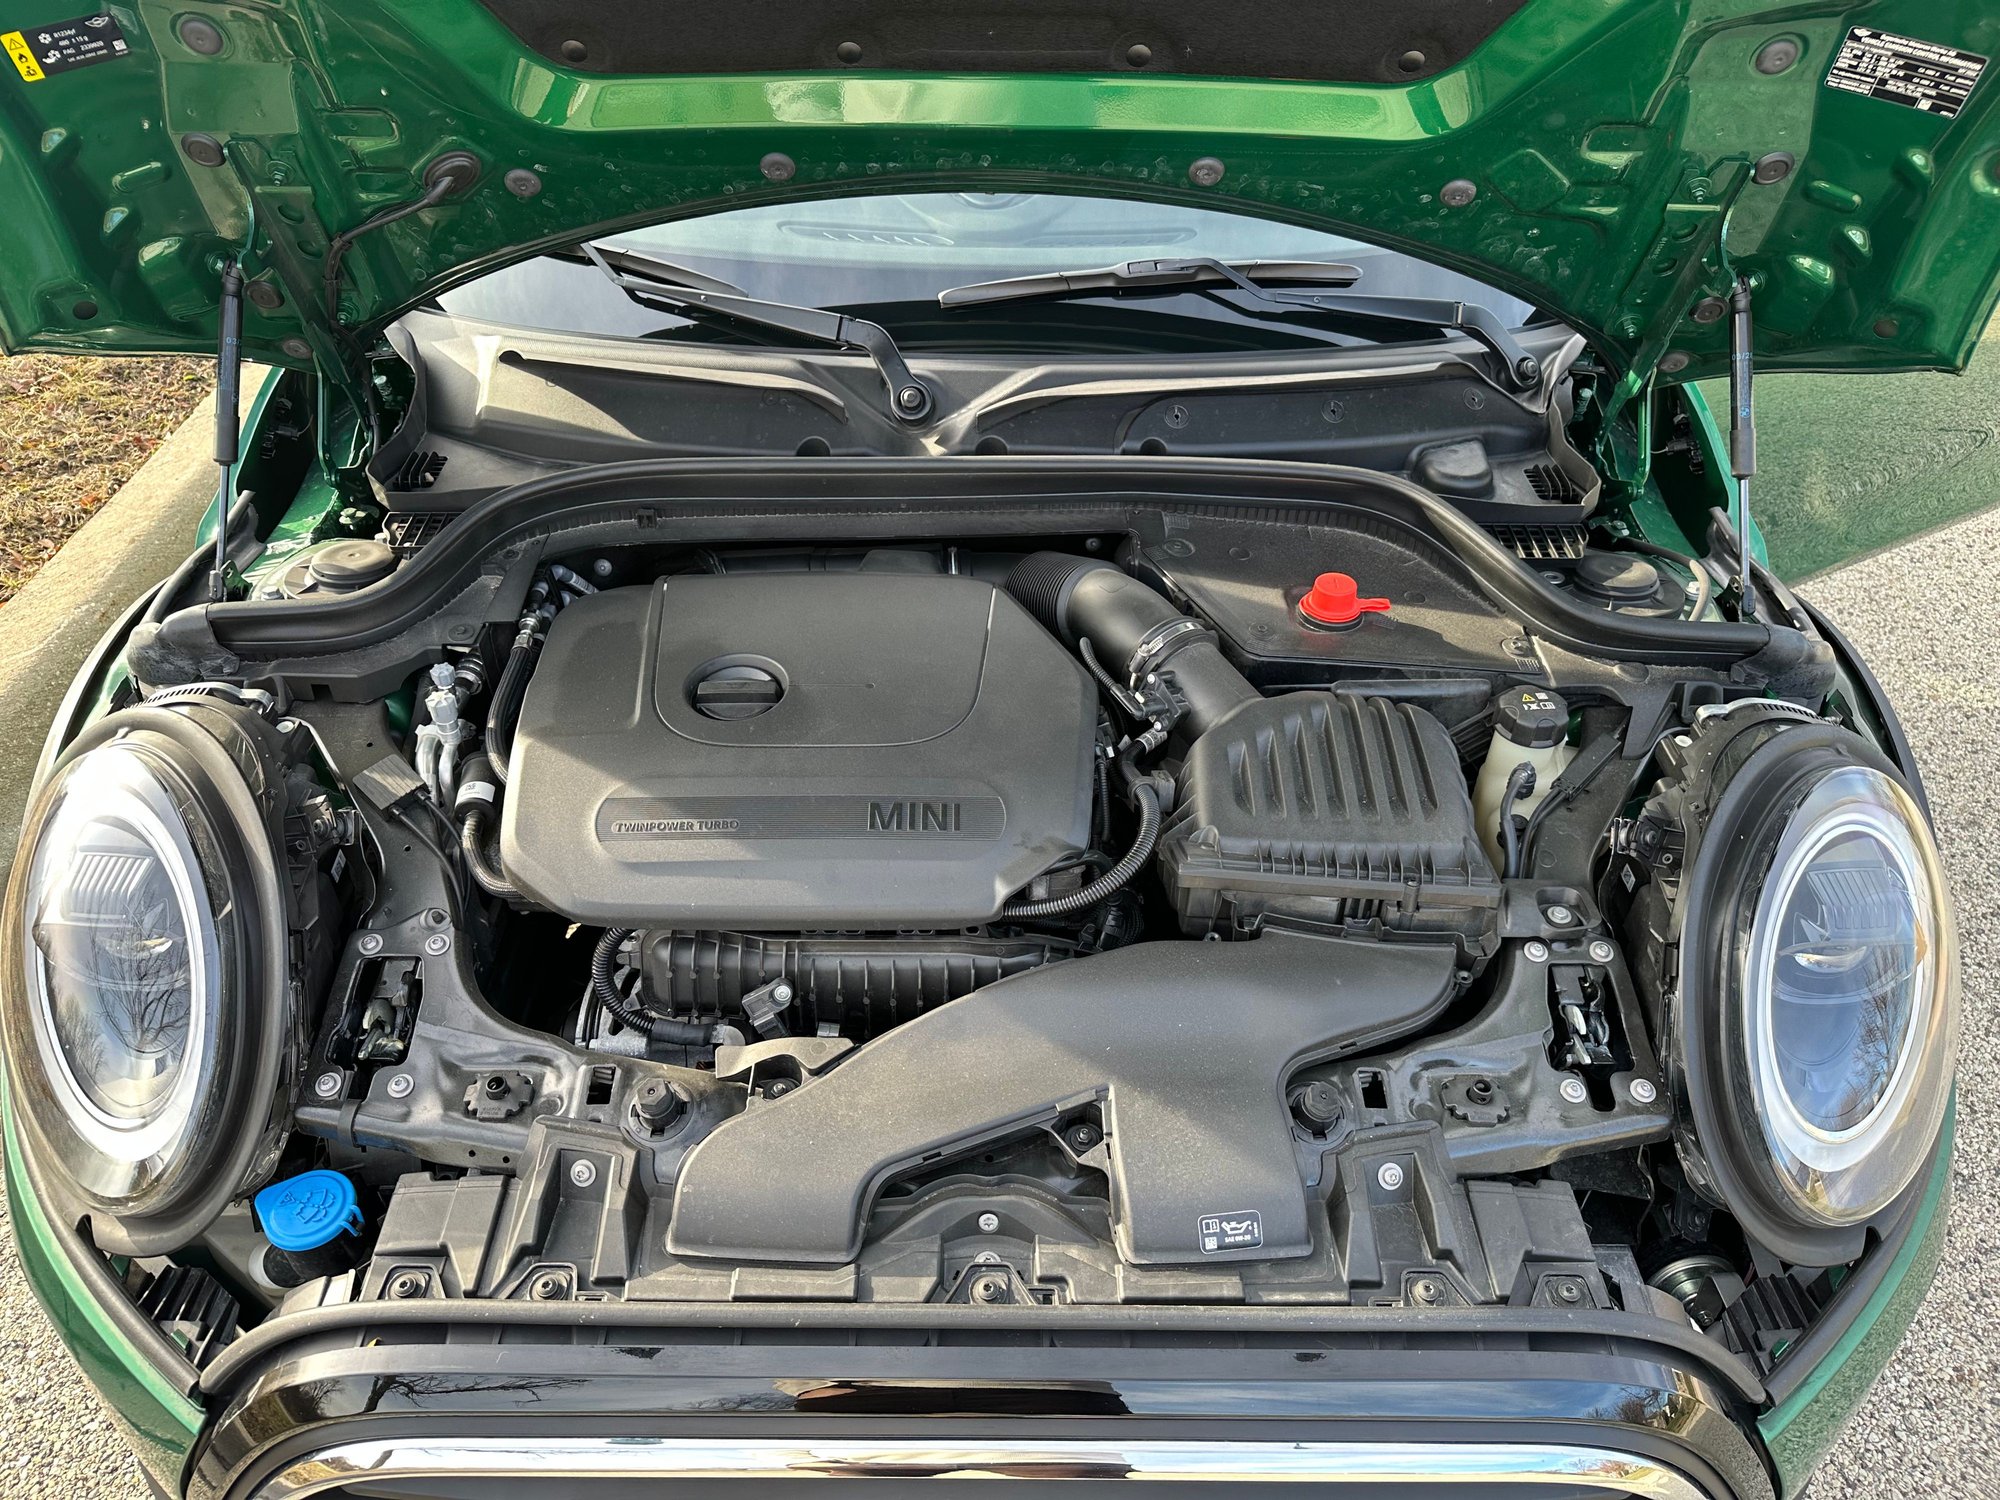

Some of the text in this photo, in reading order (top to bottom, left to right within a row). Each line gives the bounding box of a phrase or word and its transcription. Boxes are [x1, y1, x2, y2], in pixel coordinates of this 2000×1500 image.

[616, 820, 739, 833] TWINPOWER TURBO
[867, 801, 960, 832] MINI
